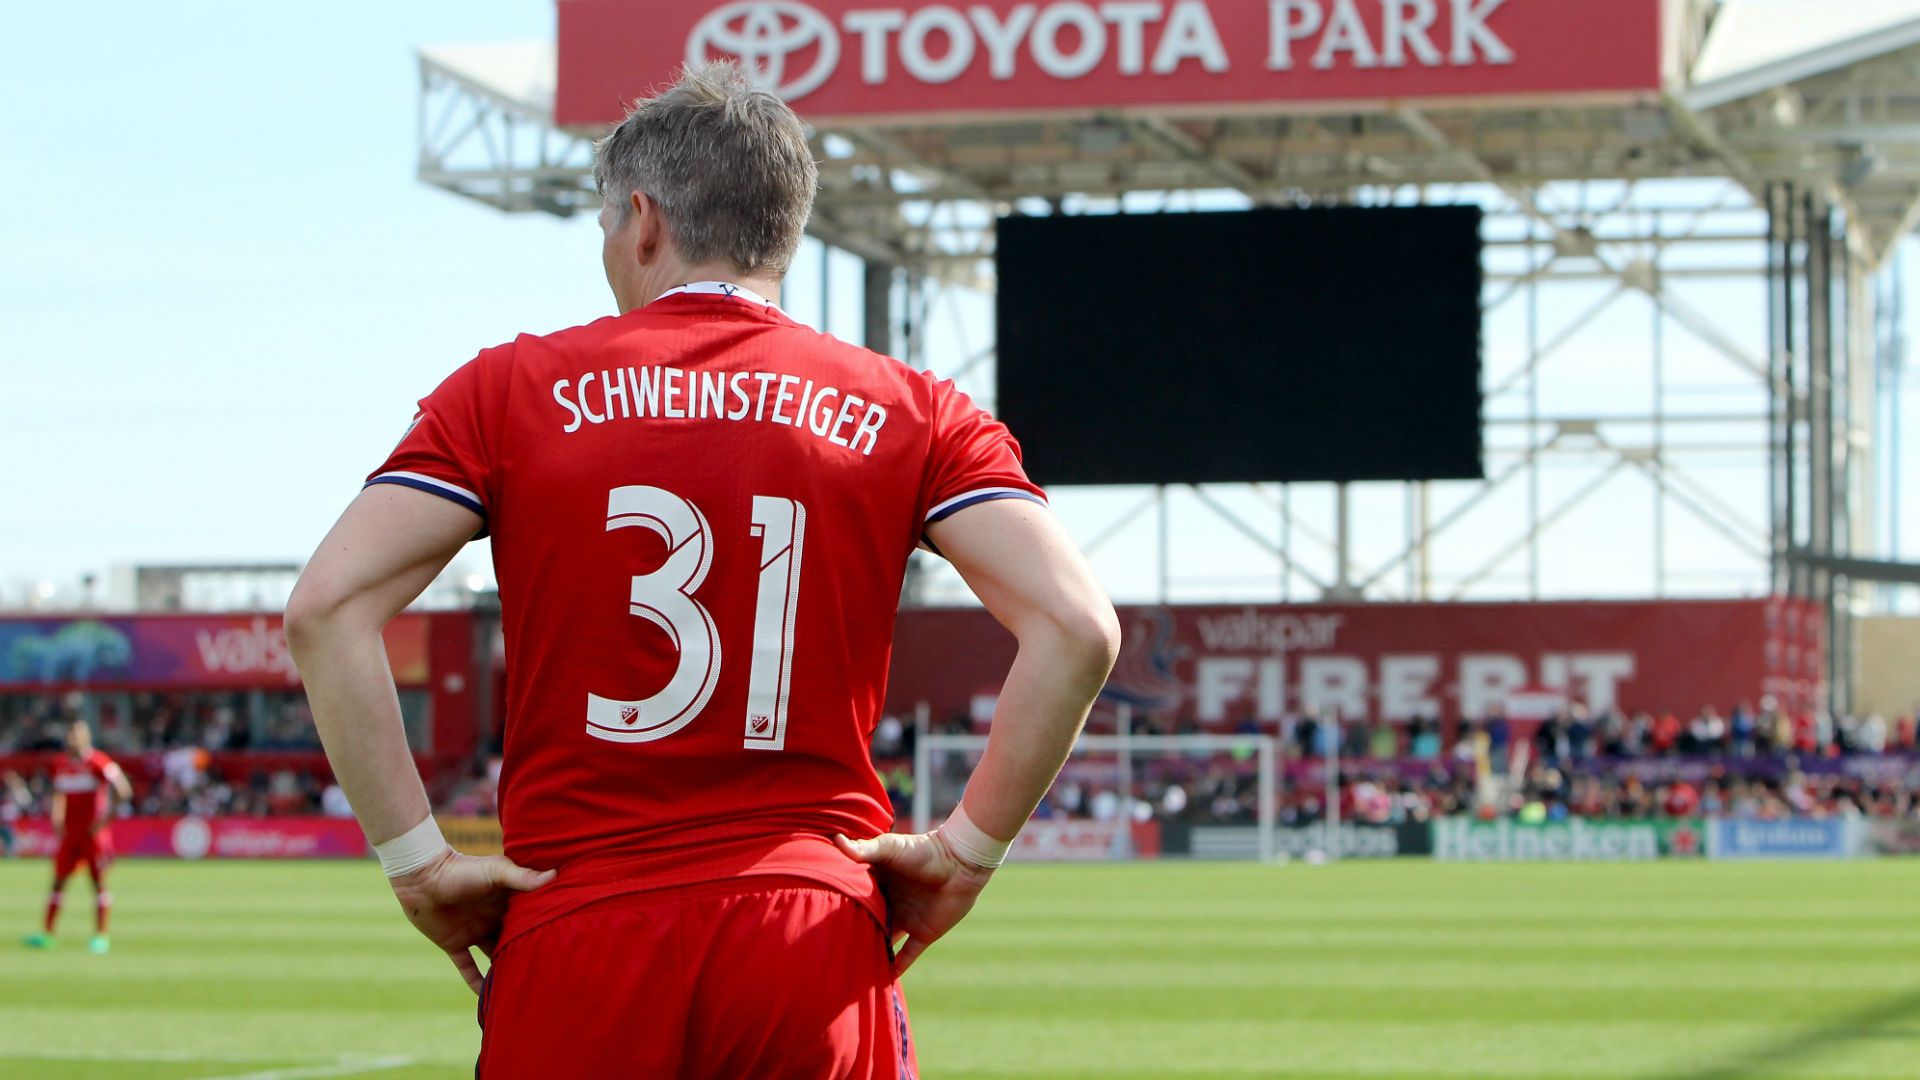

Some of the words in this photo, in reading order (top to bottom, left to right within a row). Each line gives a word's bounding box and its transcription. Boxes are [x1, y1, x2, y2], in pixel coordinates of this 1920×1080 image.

[843, 0, 1228, 83] TOYOTA
[1266, 0, 1514, 69] PARK
[552, 366, 888, 456] SCHWEINSTEIGER
[585, 484, 806, 750] 31
[1199, 609, 1341, 655] valspar
[195, 618, 302, 684] vals
[1274, 820, 1398, 859] addas
[1434, 816, 1659, 861] Heineken
